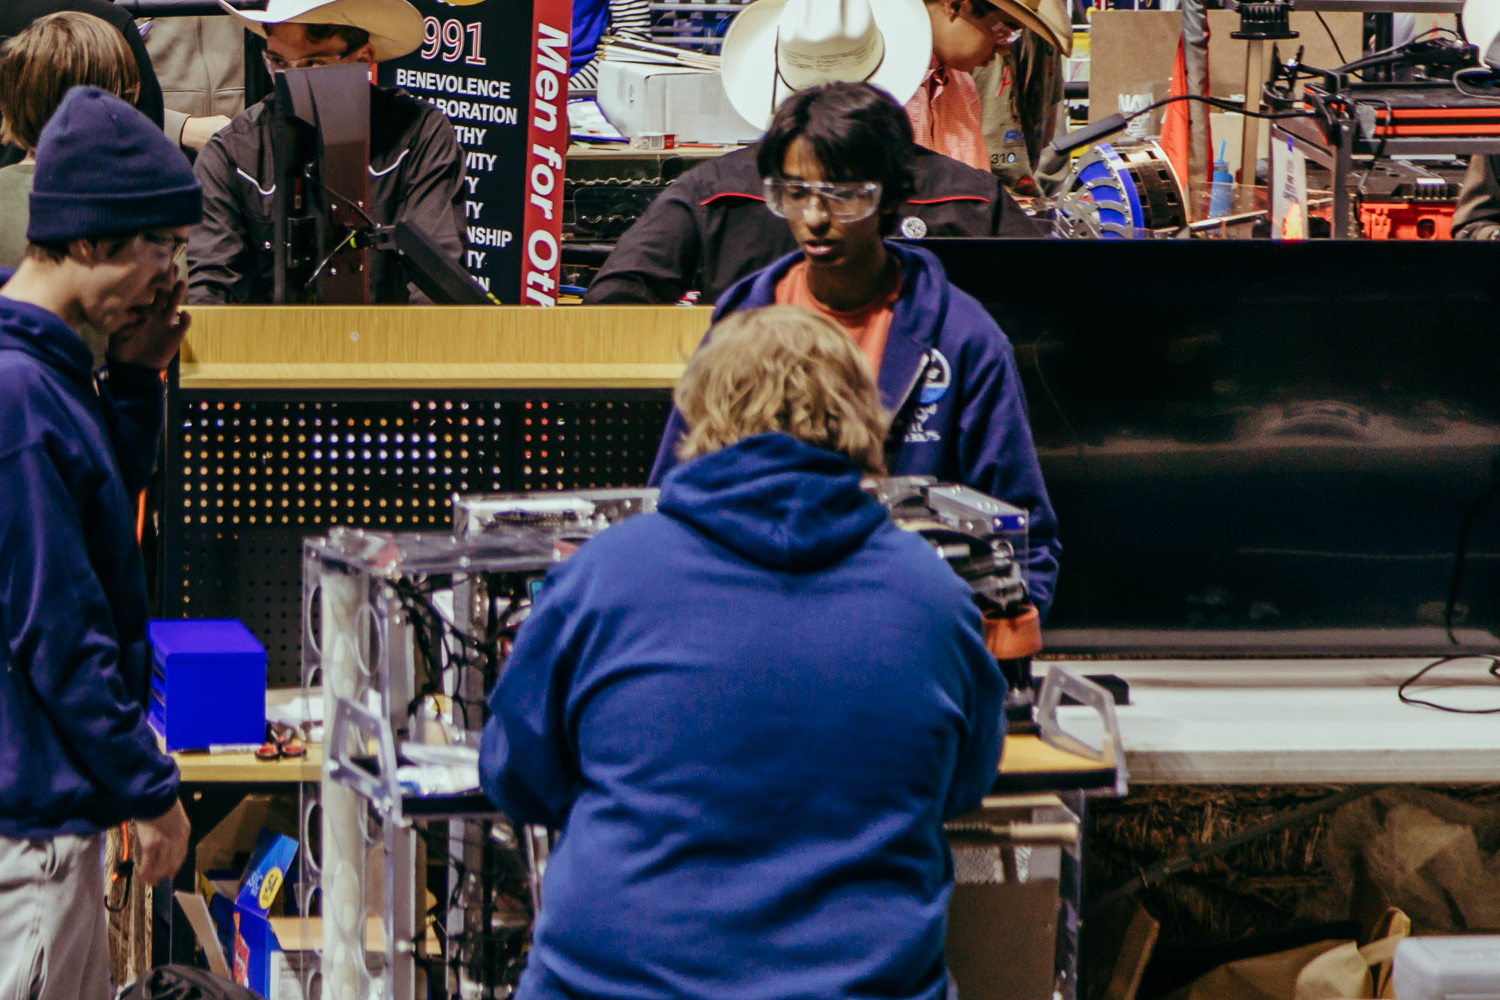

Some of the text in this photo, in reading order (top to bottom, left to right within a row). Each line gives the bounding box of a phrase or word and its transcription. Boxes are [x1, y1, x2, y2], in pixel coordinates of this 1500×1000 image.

[421, 16, 487, 66] 991
[396, 68, 511, 100] BENEVOLENCE
[533, 22, 570, 133] Men
[426, 96, 518, 125] BORATION
[453, 125, 487, 146] THY
[530, 143, 563, 220] for
[466, 225, 513, 248] NSHIP
